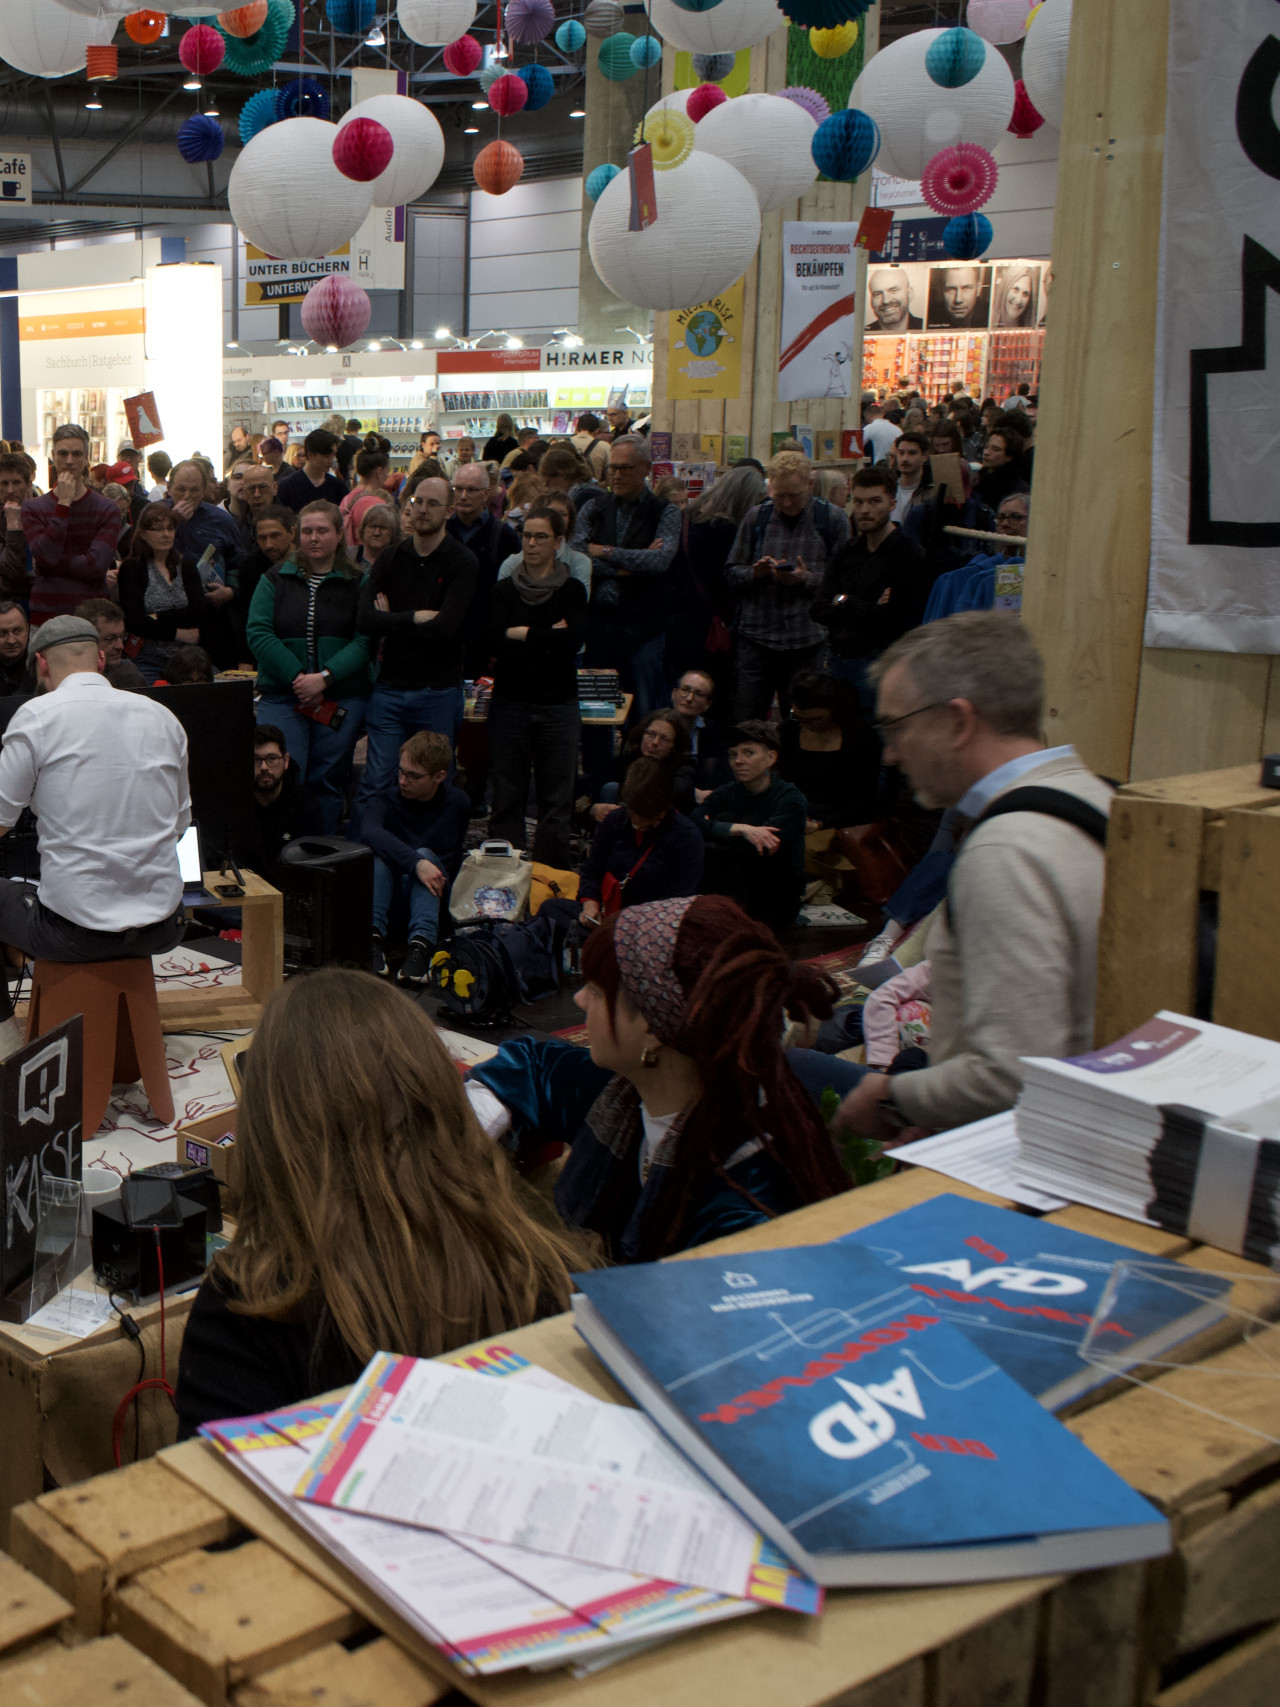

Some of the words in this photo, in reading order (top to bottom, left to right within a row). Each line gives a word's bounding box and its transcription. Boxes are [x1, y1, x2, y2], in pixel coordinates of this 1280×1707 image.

[385, 209, 393, 242] Audio
[249, 263, 288, 275] UNTER
[292, 261, 350, 274] BÜCHERN
[359, 255, 369, 270] H
[796, 258, 844, 277] BEKÄMPFEN
[491, 351, 540, 359] KUNSTFORUM
[546, 351, 623, 366] H!RMER
